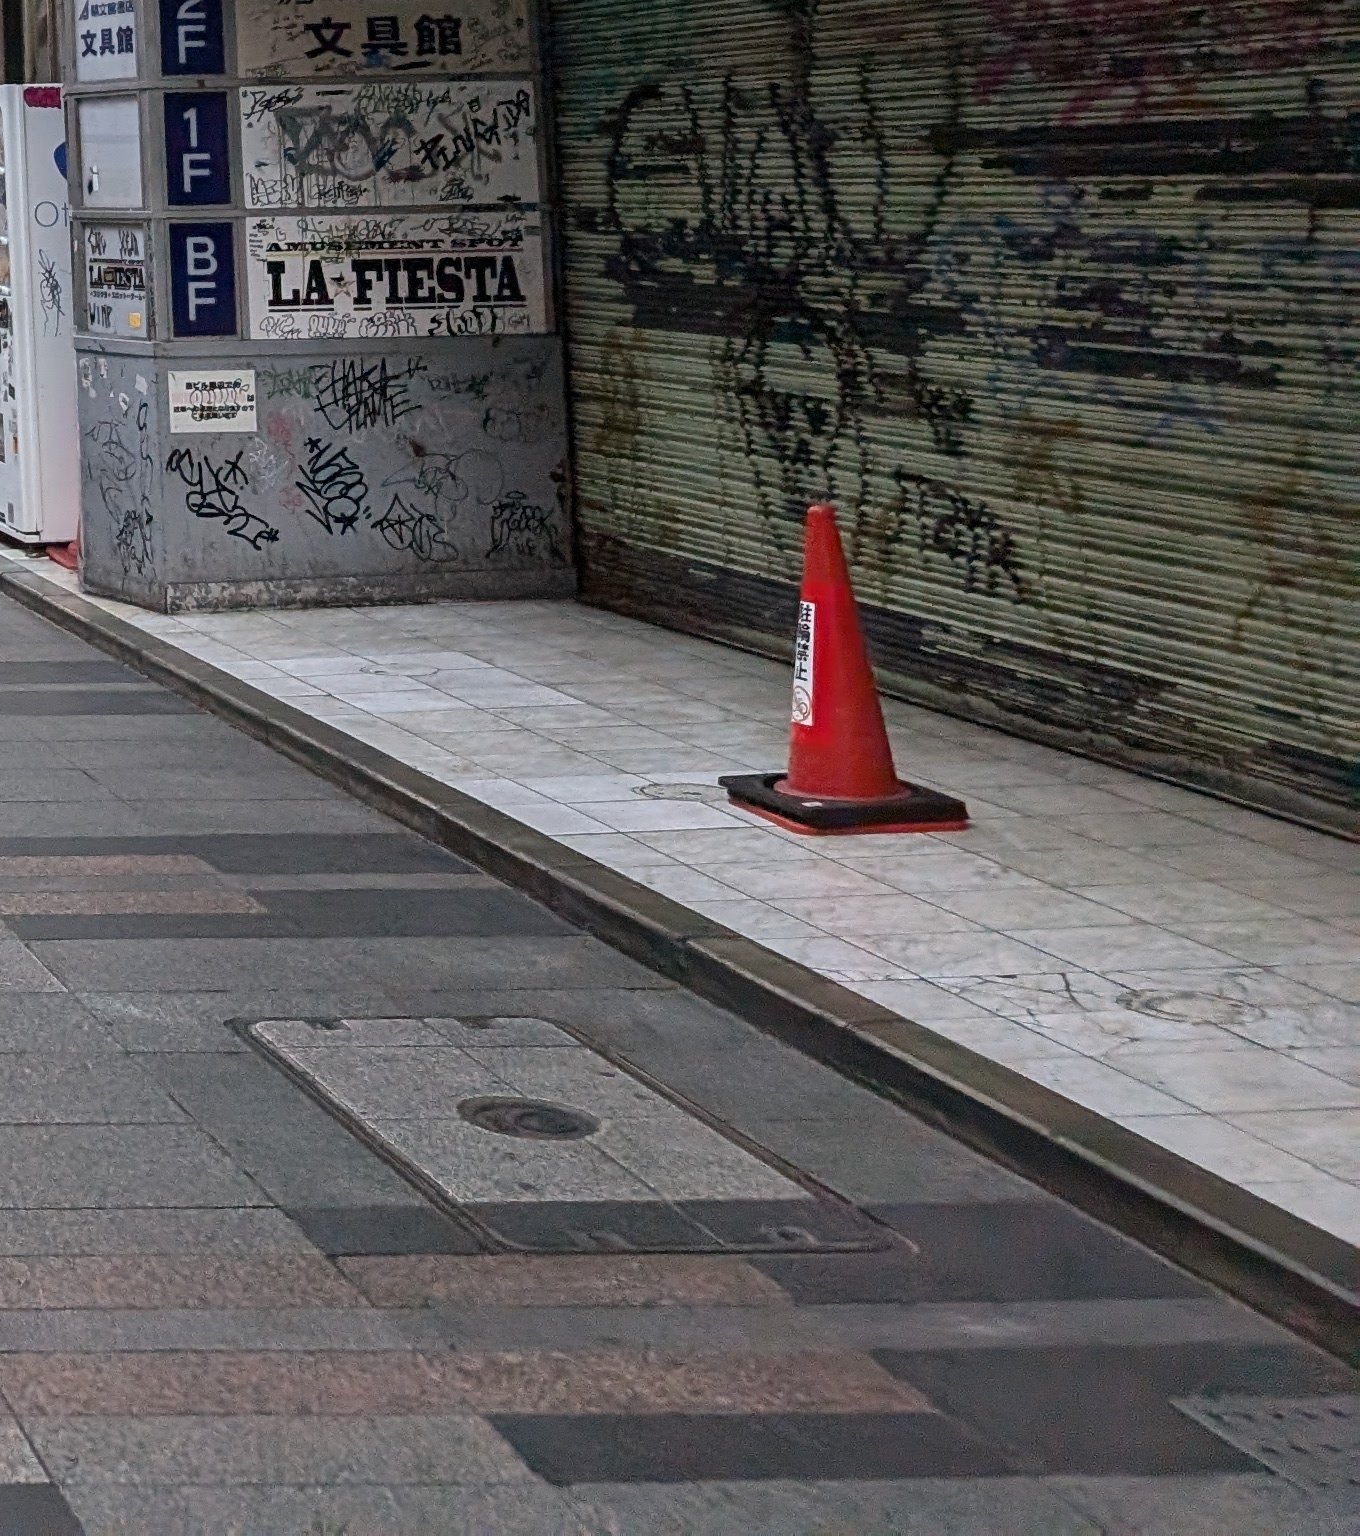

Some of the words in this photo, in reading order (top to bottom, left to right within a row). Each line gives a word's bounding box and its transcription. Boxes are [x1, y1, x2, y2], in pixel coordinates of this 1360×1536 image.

[81, 25, 135, 58] 文具館
[304, 14, 464, 59] 文具館
[181, 106, 211, 194] 1F
[265, 238, 444, 254] AMUSEMENT
[88, 266, 103, 290] LA
[185, 235, 219, 322] BF
[266, 259, 335, 309] LA
[351, 255, 527, 306] FIESTA
